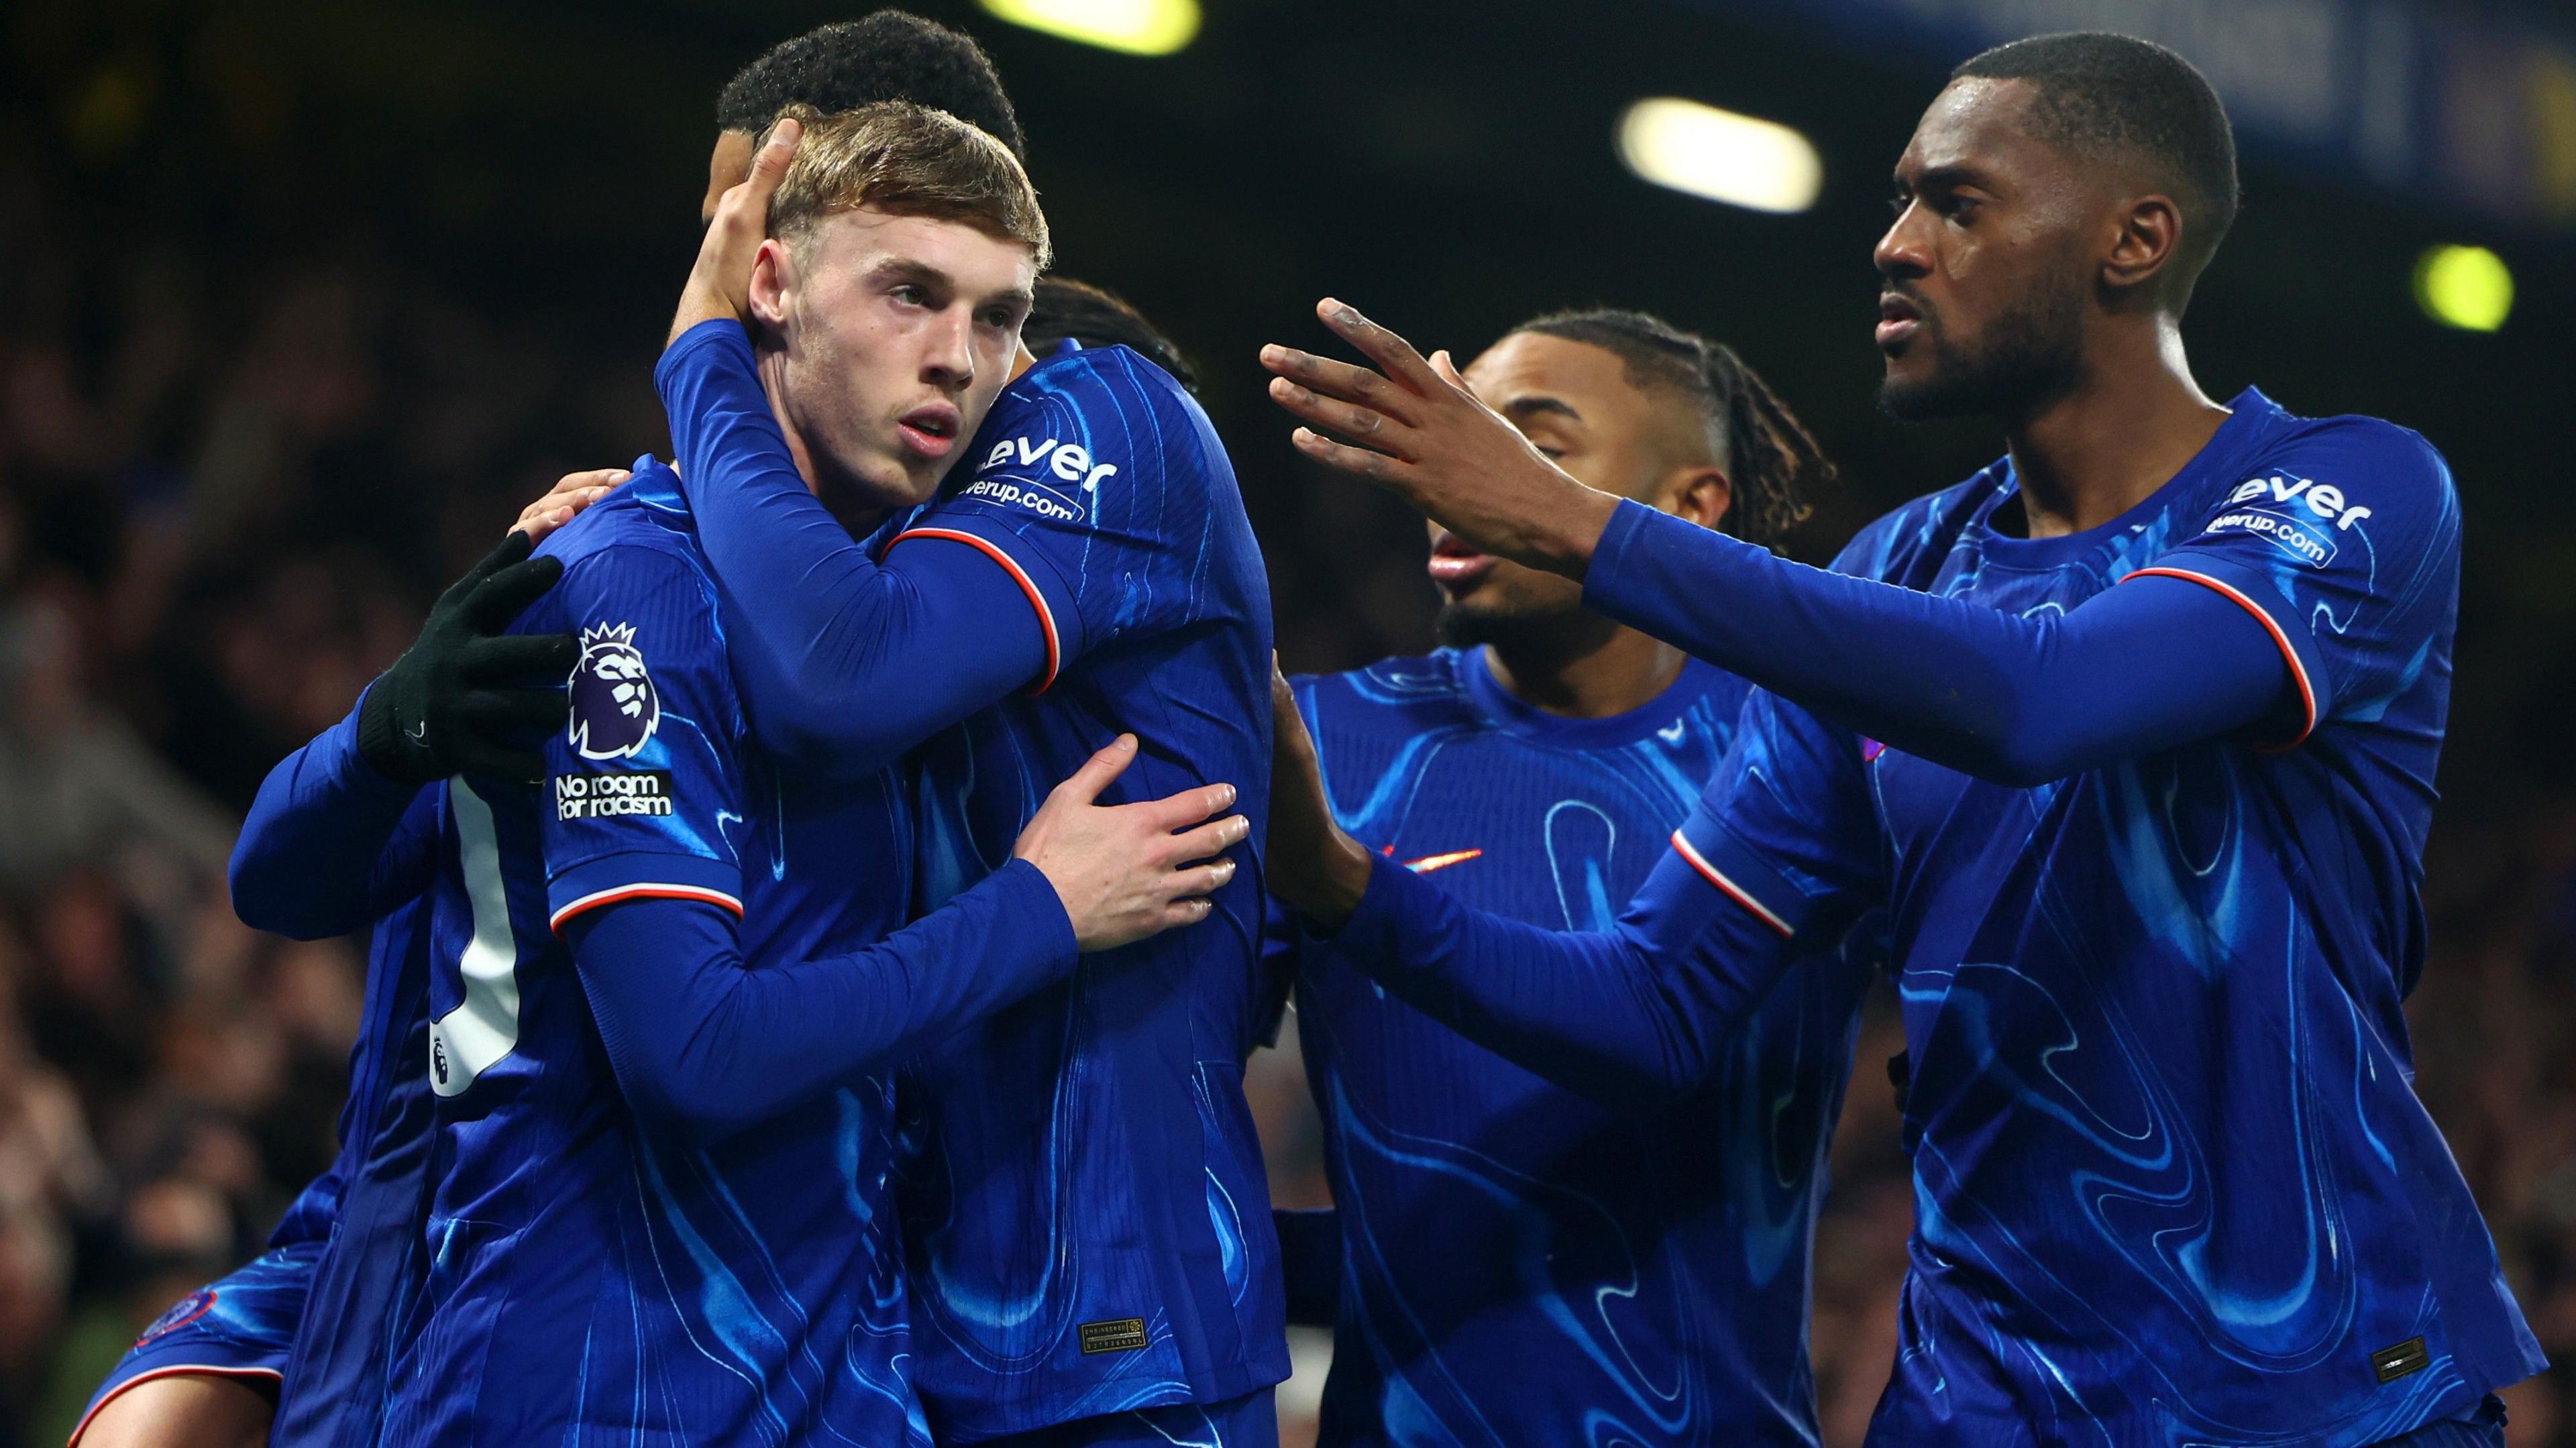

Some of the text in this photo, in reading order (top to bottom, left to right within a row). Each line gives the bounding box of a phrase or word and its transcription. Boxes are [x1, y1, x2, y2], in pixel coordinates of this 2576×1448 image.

[976, 437, 1117, 492] ever
[964, 480, 1074, 520] verup.com
[2220, 476, 2371, 531] ever
[555, 774, 659, 799] No room
[557, 795, 672, 821] for racism
